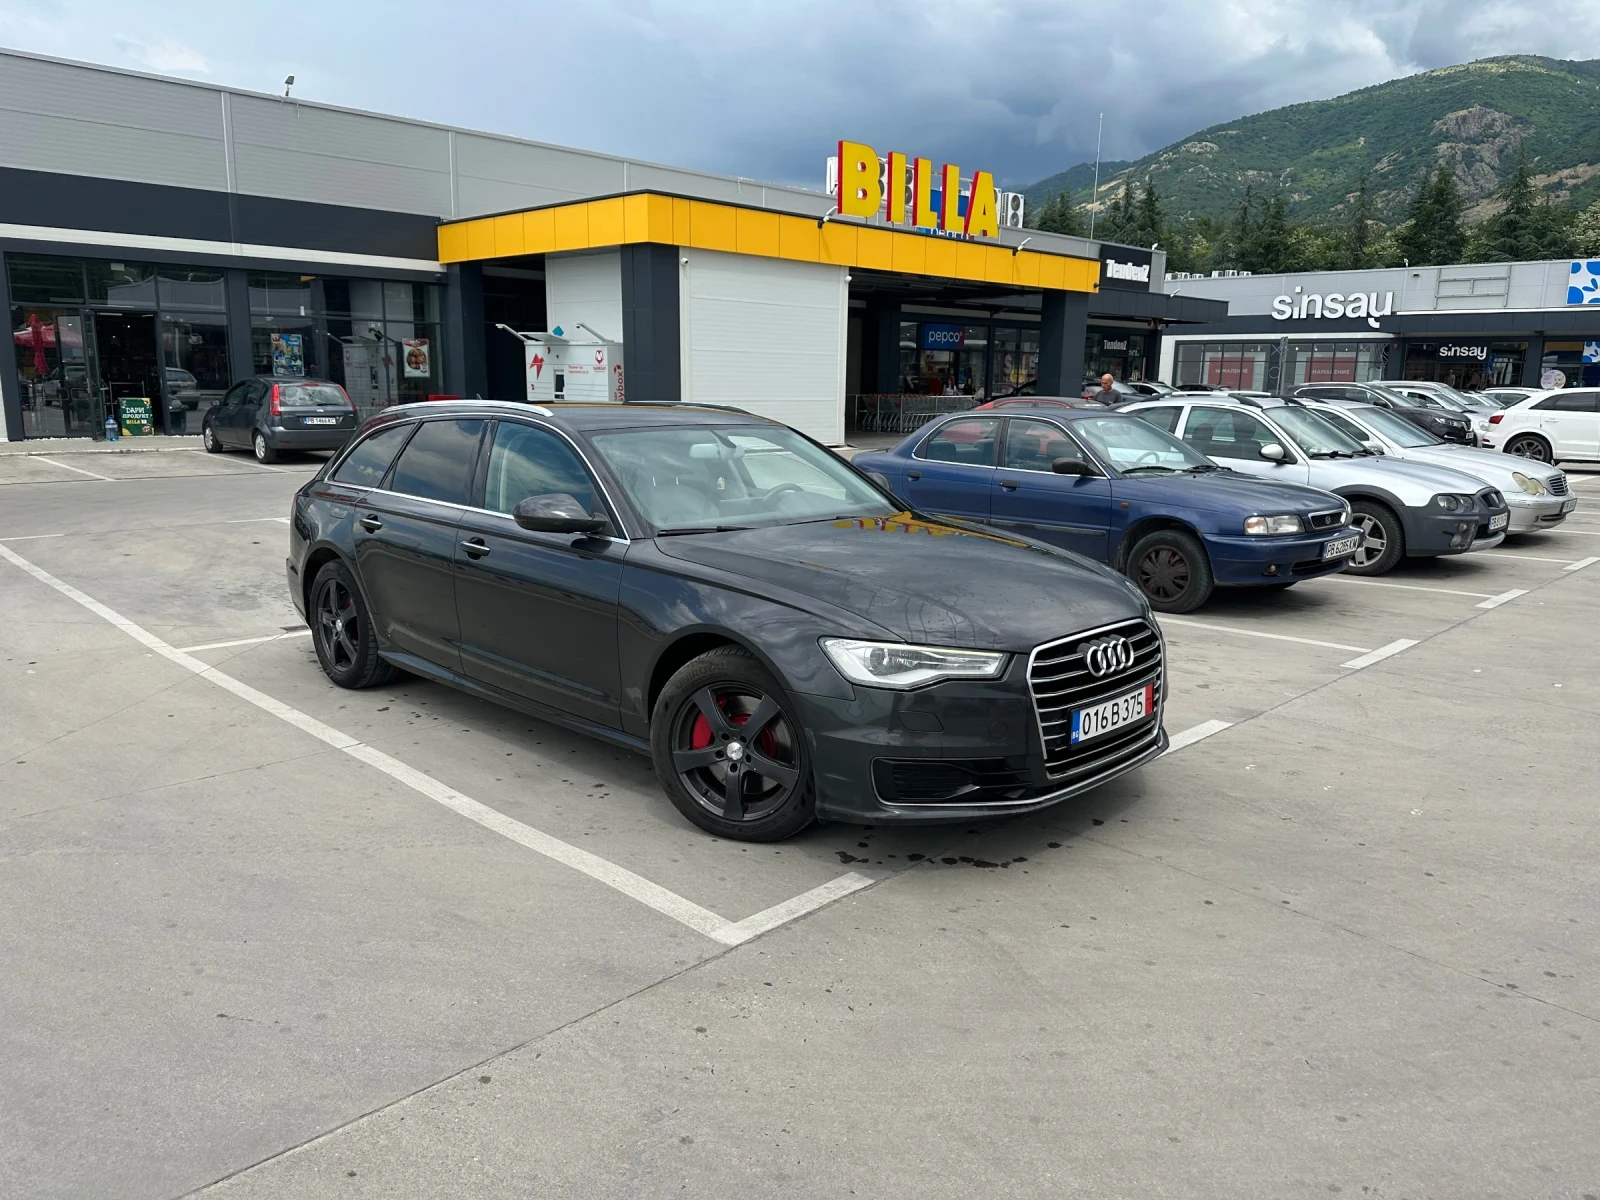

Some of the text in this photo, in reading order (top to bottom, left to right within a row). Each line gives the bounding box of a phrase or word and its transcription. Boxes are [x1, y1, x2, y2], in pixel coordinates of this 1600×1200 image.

[838, 139, 999, 238] BILLA
[1271, 285, 1394, 329] sinsay
[928, 331, 960, 343] pepco
[1439, 343, 1488, 361] sinsay
[1003, 354, 1036, 375] SLE
